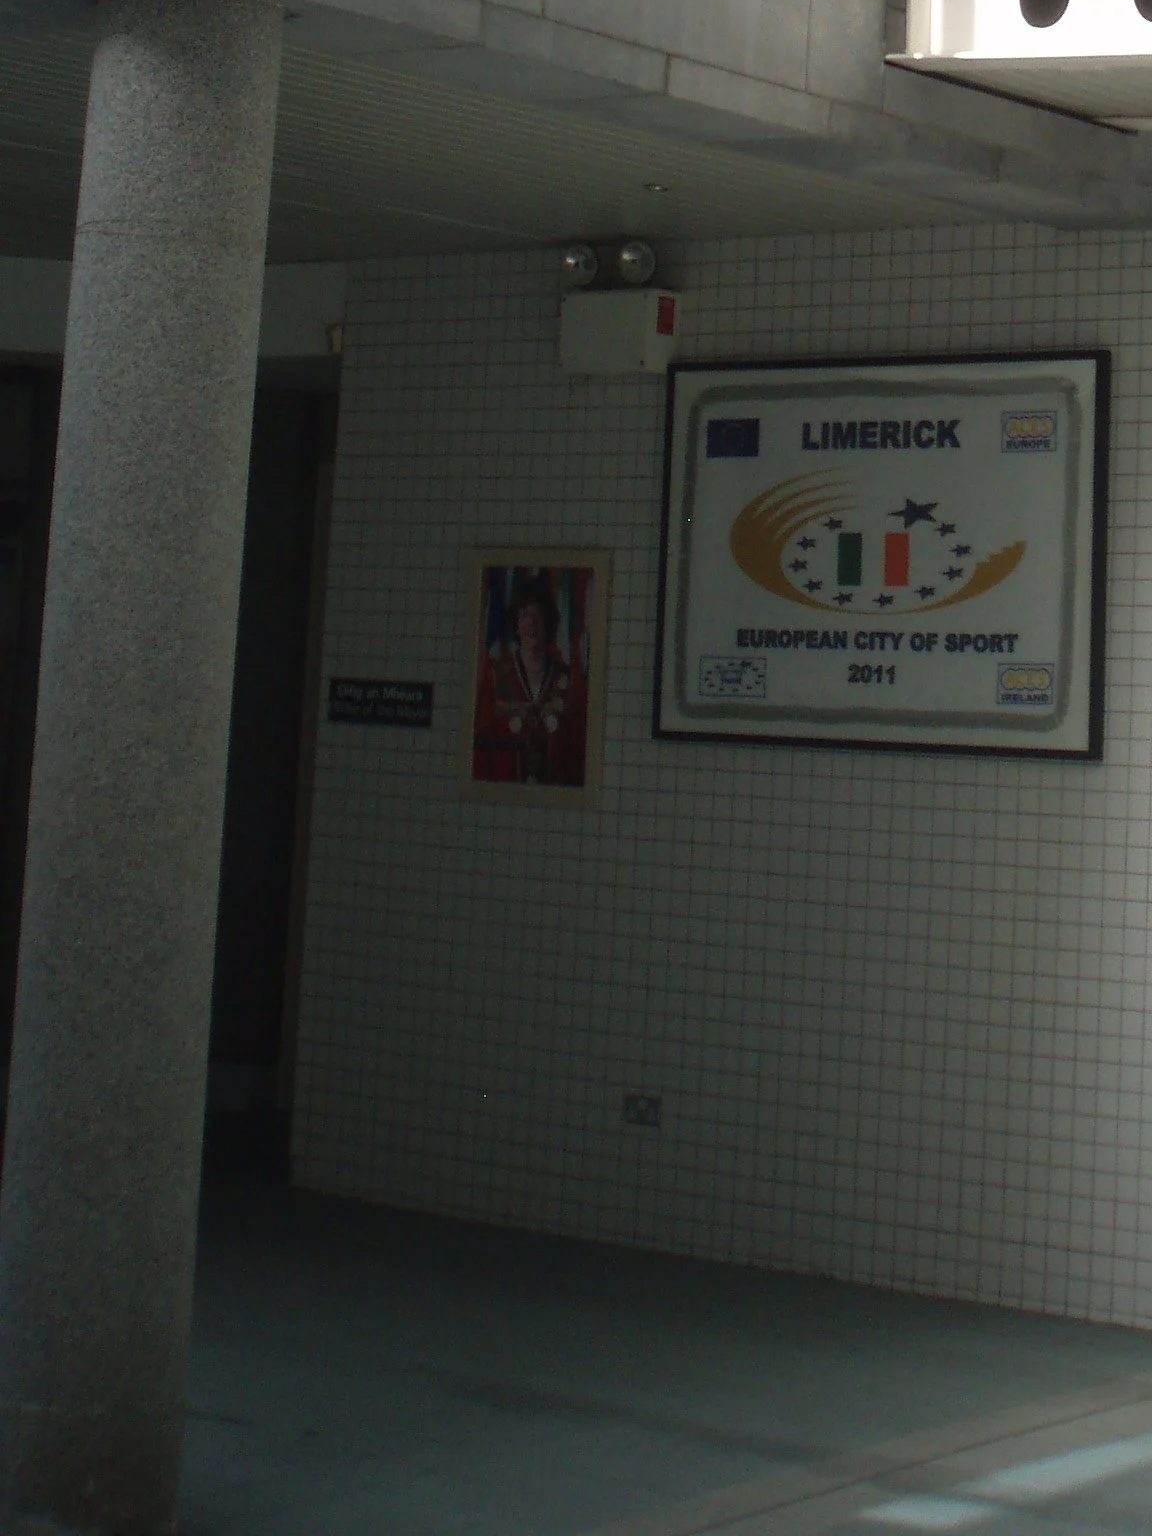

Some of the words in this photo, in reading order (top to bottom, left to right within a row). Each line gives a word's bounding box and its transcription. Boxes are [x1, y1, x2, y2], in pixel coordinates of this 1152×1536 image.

[801, 419, 961, 451] LIMERICK
[1006, 439, 1051, 449] EUROPE
[736, 628, 847, 650] EUROPEAN
[854, 630, 904, 651] CITY
[909, 632, 938, 652] OF
[944, 632, 1019, 654] SPORT
[847, 663, 896, 685] 2011
[1001, 693, 1049, 703] IRELAND
